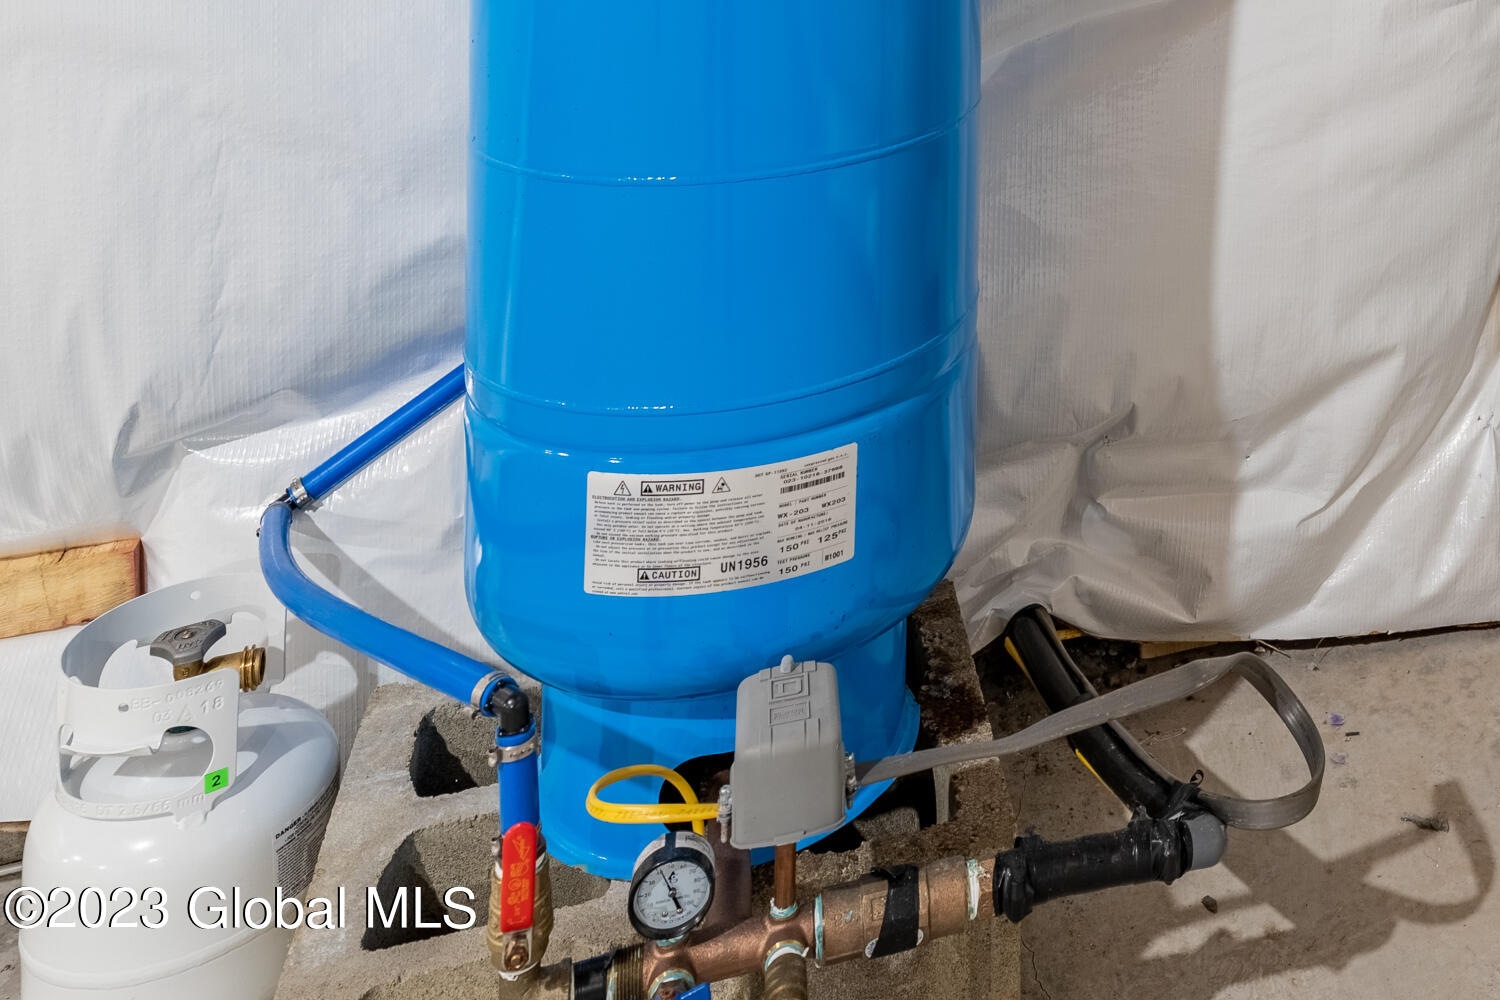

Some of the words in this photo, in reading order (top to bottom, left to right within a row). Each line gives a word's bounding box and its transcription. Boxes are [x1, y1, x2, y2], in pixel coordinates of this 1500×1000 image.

[655, 482, 702, 493] WARNING
[777, 507, 809, 520] WX-203
[822, 496, 846, 508] WX203
[818, 531, 838, 544] 125
[779, 543, 799, 553] 150
[720, 555, 768, 573] UN1956
[651, 570, 697, 580] CAUTION
[779, 565, 798, 575] 150
